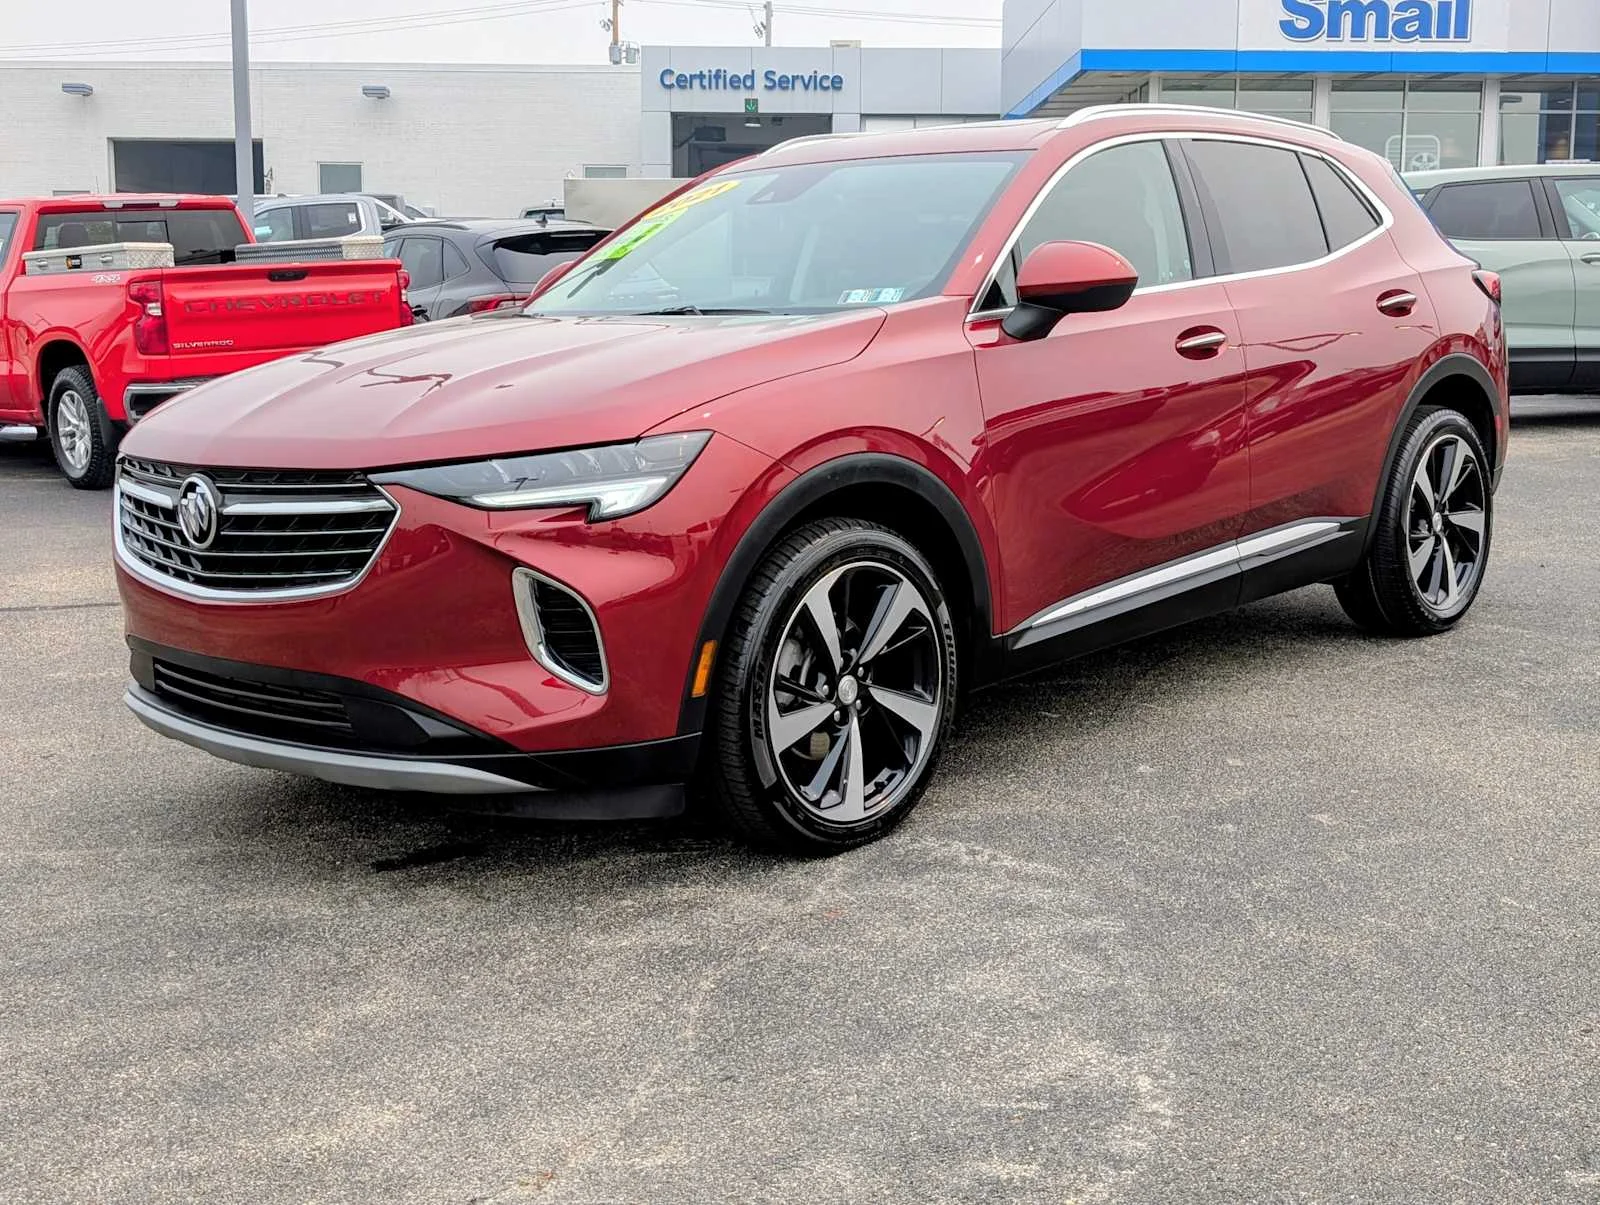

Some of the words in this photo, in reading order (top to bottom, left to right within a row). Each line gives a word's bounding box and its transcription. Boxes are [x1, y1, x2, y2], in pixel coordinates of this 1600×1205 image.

[1279, 0, 1472, 42] Smail
[660, 69, 755, 90] Certified
[764, 69, 843, 91] Service
[185, 291, 384, 314] CHEVROLET
